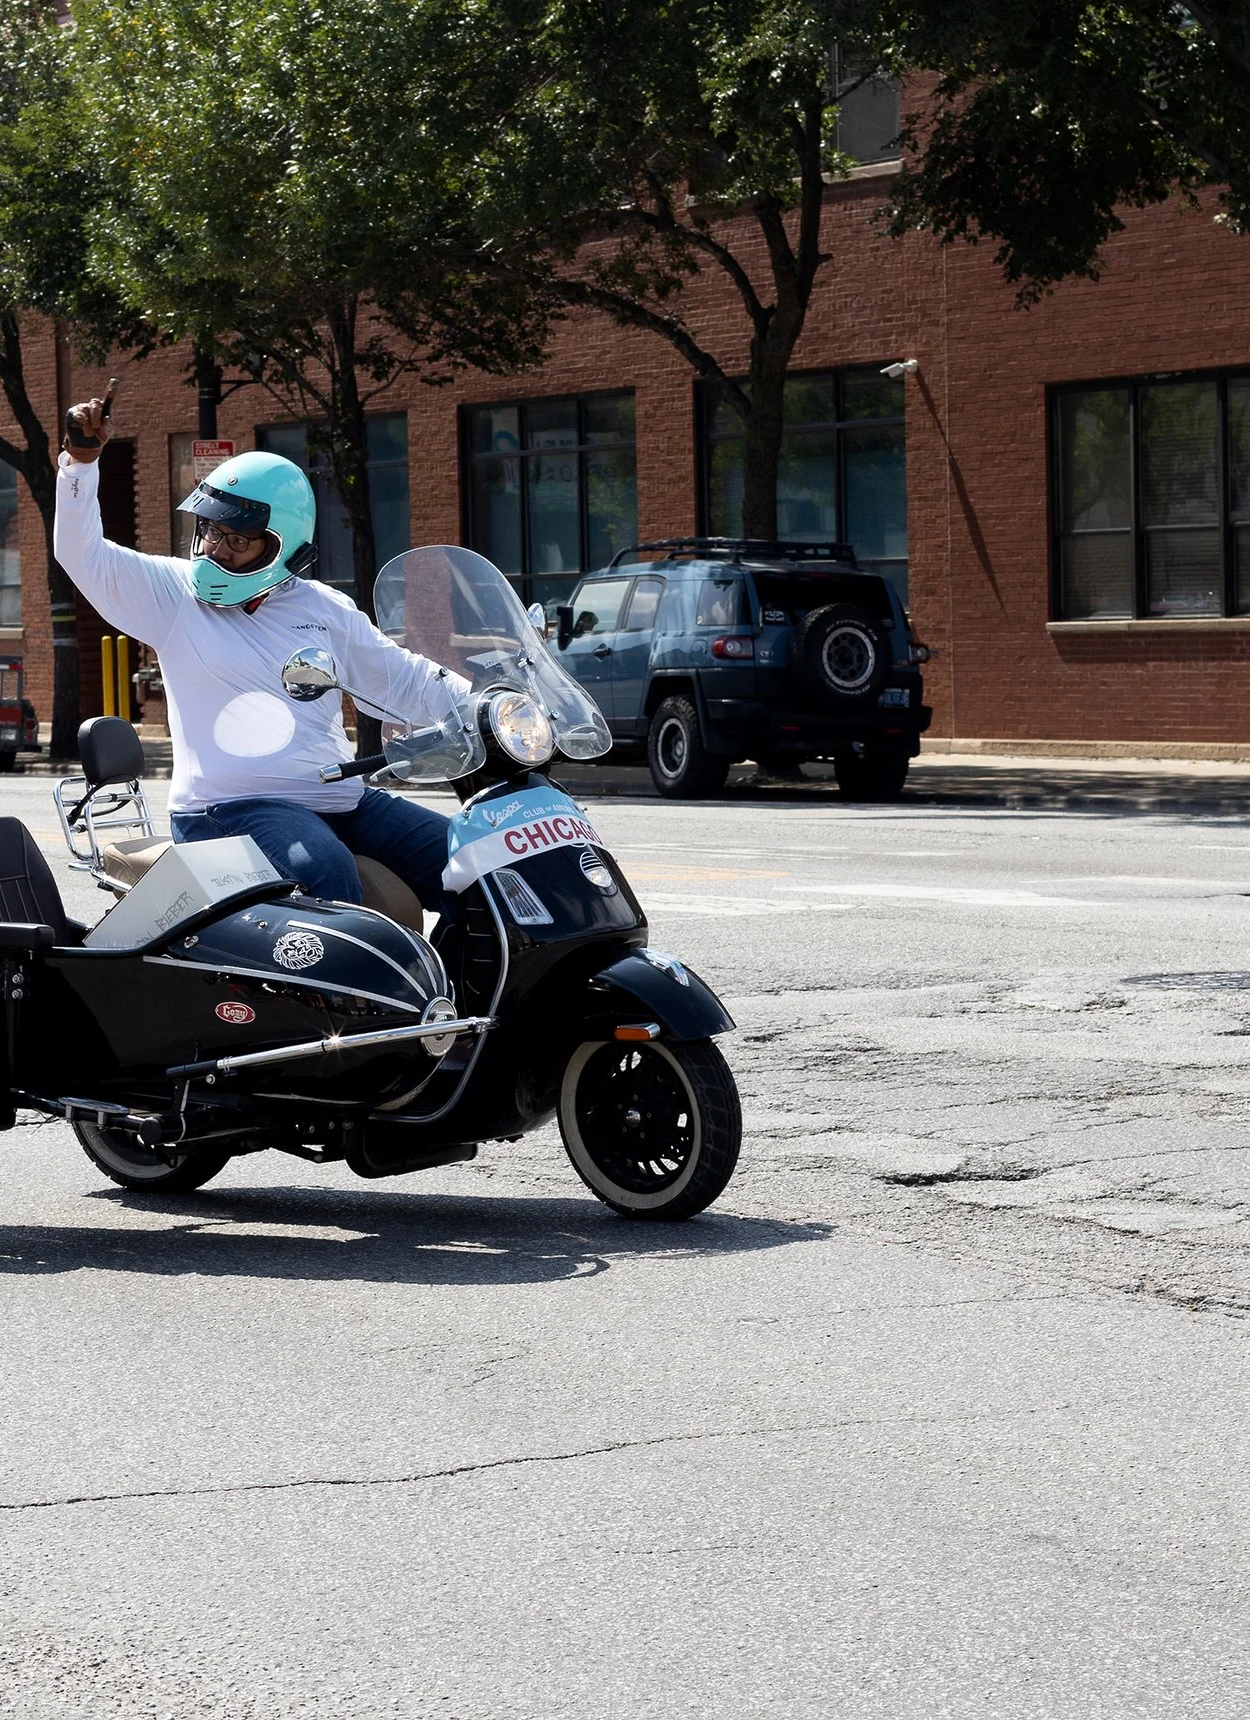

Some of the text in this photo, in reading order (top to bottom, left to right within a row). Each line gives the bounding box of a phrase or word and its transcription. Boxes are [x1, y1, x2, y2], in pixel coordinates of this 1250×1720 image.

[195, 442, 220, 450] STREET
[481, 800, 524, 828] Vespa
[523, 807, 546, 819] CLUB
[504, 816, 604, 855] CHICAGO
[154, 890, 195, 932] BIEBER
